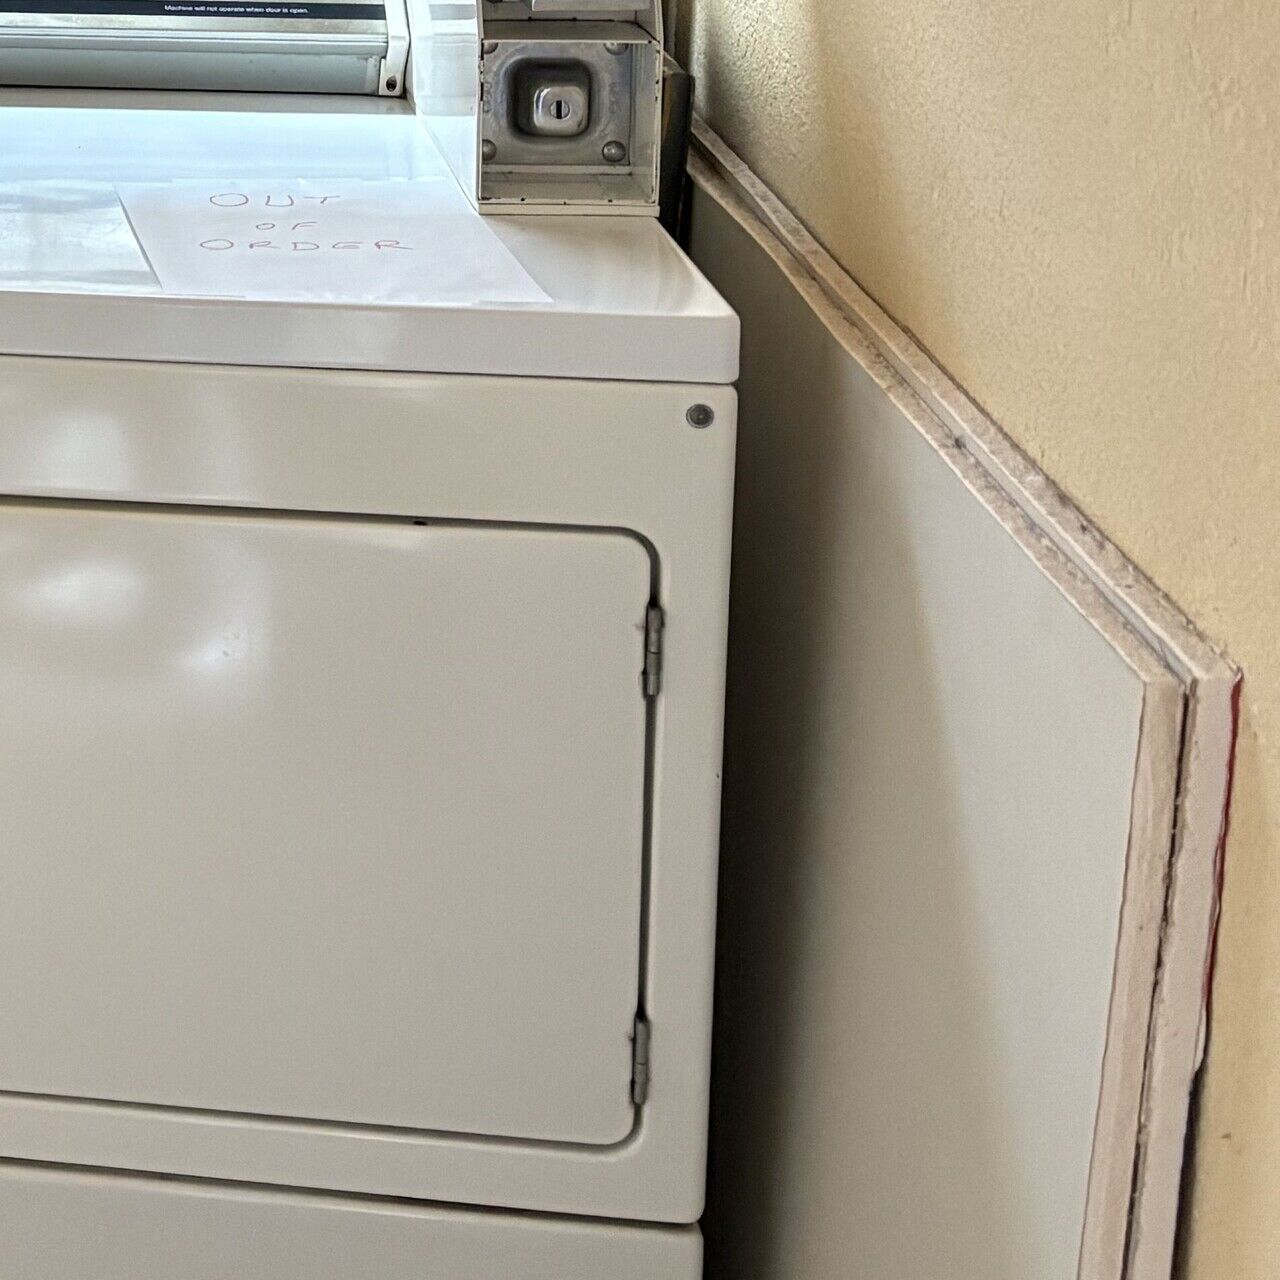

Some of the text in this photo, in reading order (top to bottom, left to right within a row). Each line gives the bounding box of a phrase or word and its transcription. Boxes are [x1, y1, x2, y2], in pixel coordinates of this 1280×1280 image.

[209, 193, 340, 207] OUT
[256, 221, 318, 231] OF
[199, 239, 413, 251] ORDER
